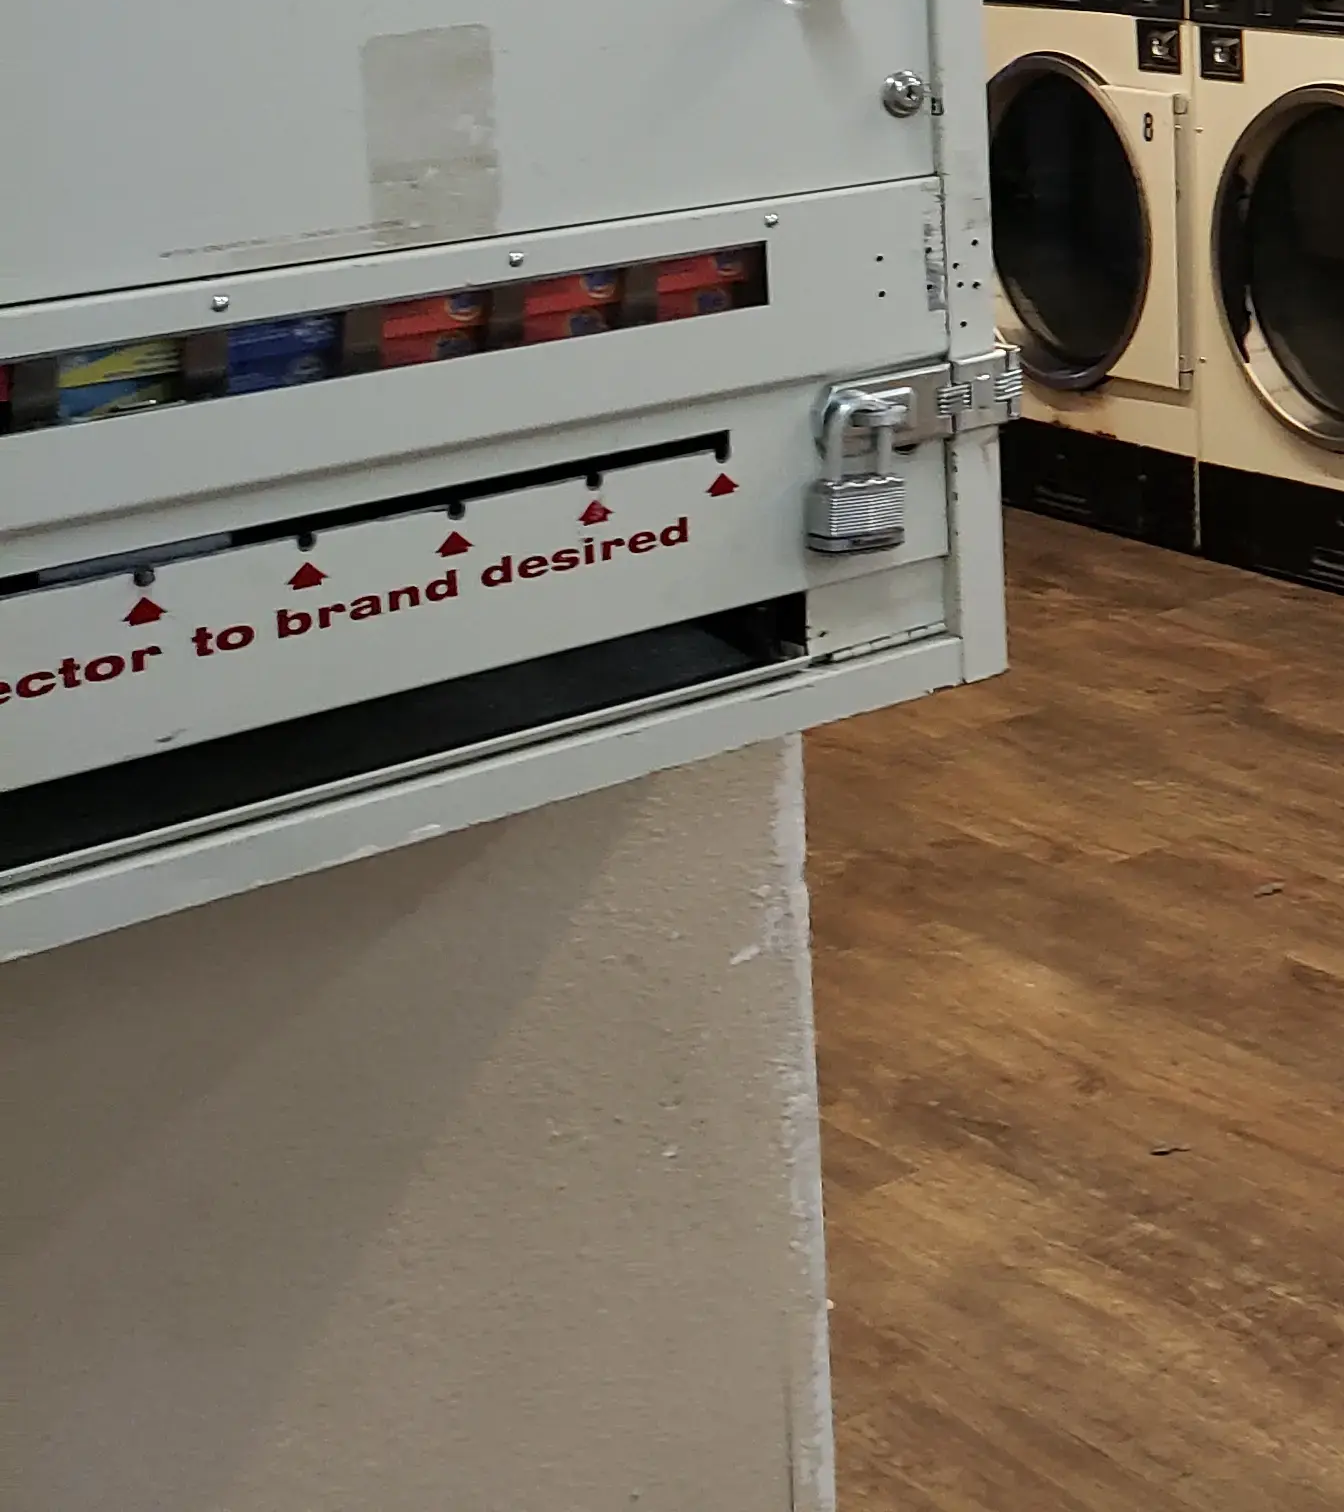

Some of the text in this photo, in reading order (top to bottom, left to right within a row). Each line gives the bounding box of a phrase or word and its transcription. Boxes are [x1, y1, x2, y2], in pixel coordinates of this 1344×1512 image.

[1142, 111, 1156, 143] 8
[190, 624, 256, 658] to
[276, 569, 459, 639] brand
[481, 516, 690, 588] desired
